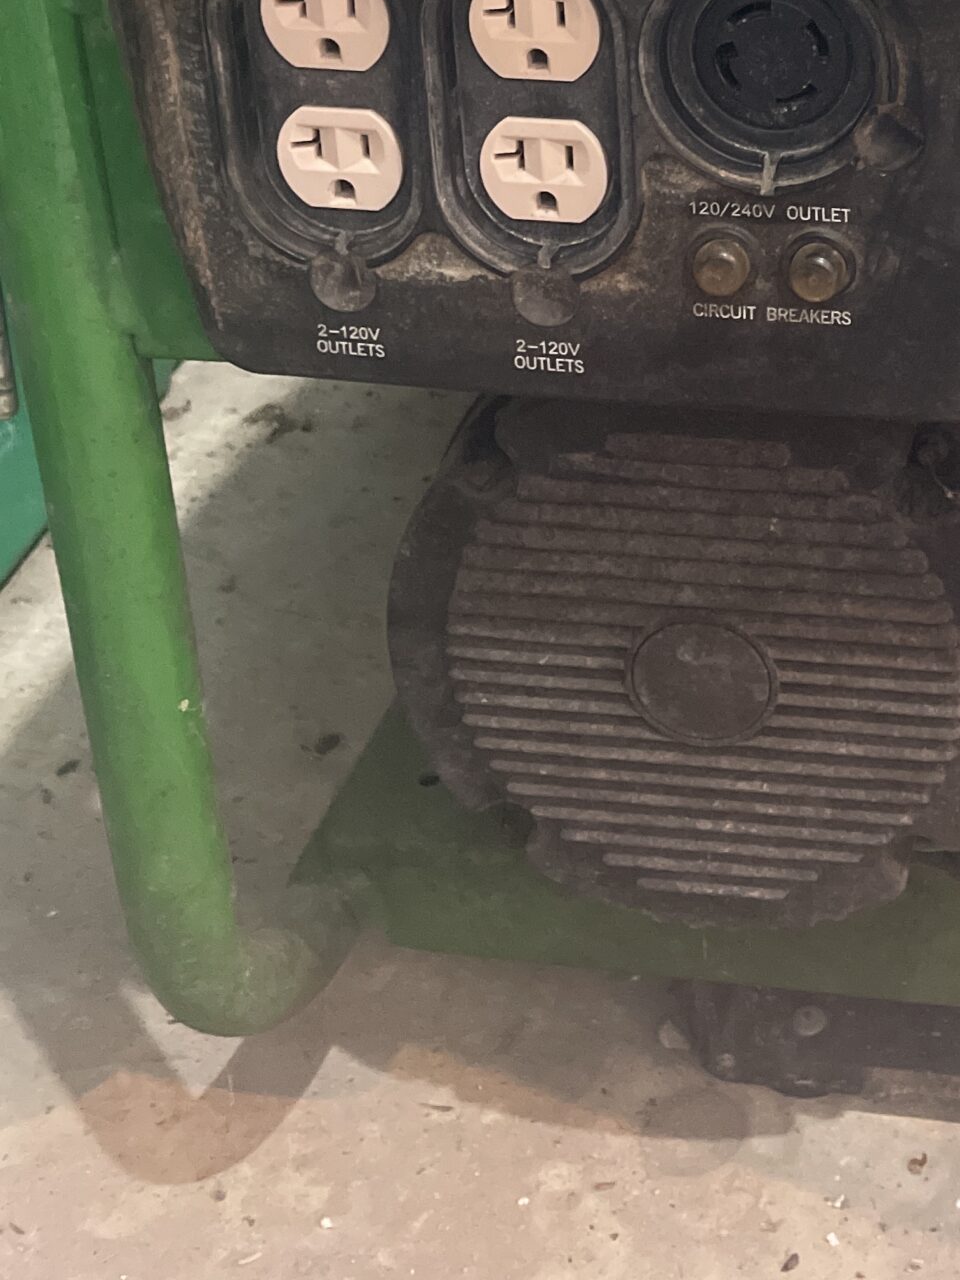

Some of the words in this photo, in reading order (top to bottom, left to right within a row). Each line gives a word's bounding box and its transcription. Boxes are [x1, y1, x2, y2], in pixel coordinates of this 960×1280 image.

[689, 201, 776, 219] 120/240V
[786, 206, 851, 223] OUTLET
[692, 303, 757, 320] CIRCUIT
[766, 307, 852, 326] BREAKERS
[317, 323, 381, 341] 2-120V
[316, 340, 385, 358] OUTLETS
[515, 339, 581, 357] 2-120V
[514, 355, 585, 374] OUTLETS
